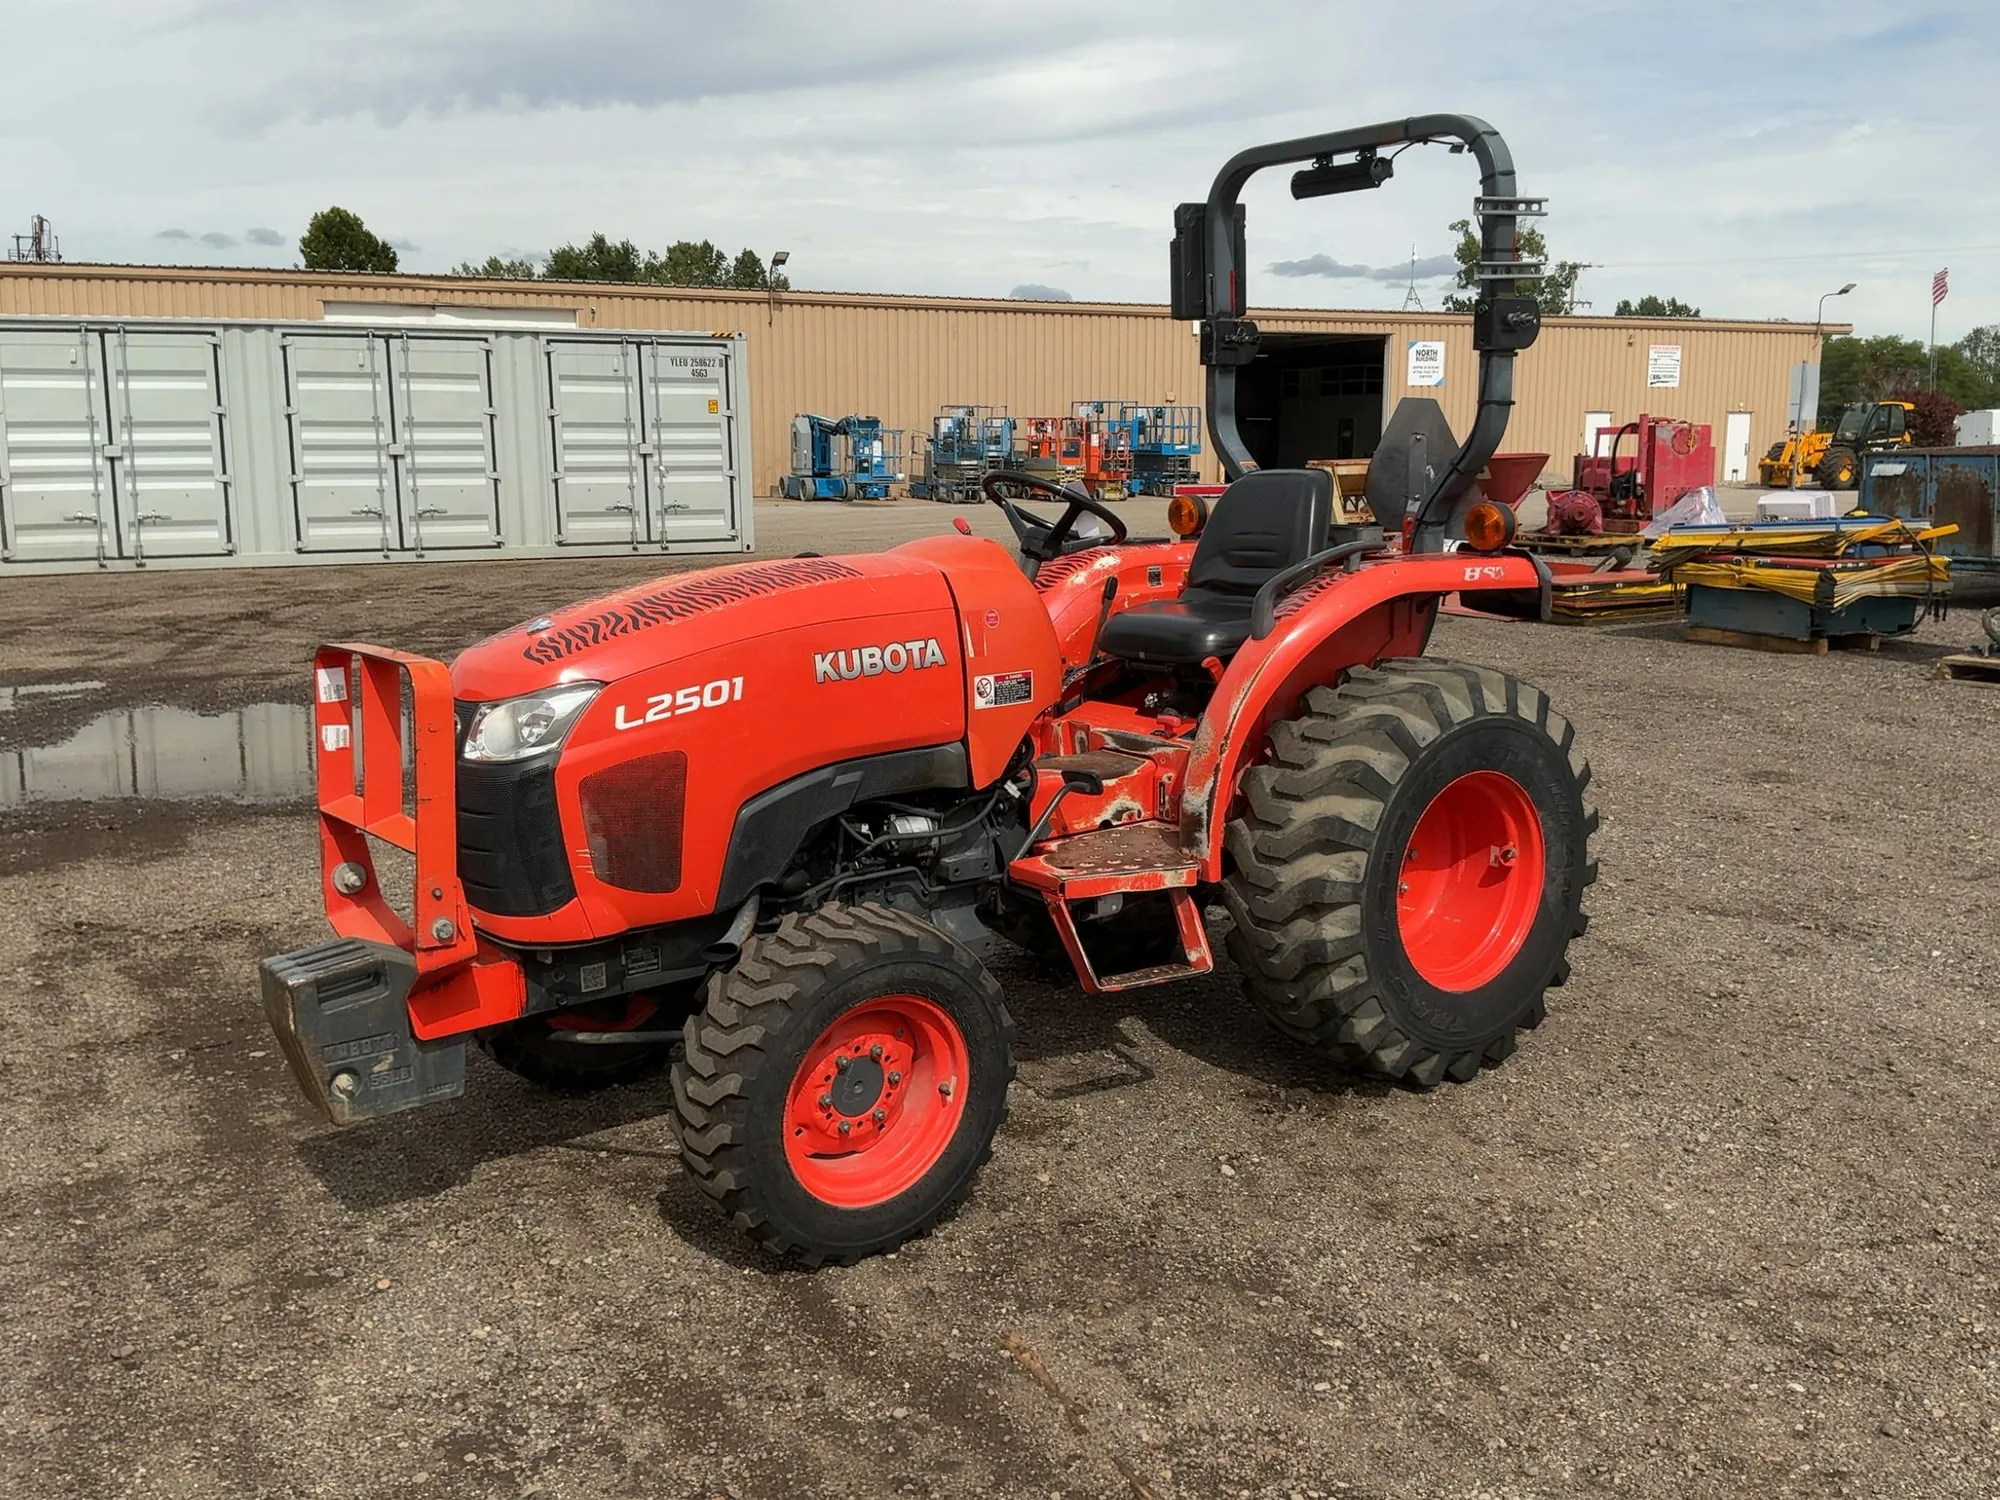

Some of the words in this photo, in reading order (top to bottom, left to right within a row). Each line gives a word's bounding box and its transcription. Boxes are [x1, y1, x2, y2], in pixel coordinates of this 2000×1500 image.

[670, 357, 689, 367] YLEU
[718, 358, 724, 368] 8
[1415, 349, 1438, 357] NORTH
[814, 638, 946, 684] KUBOTA
[614, 676, 744, 732] L2501
